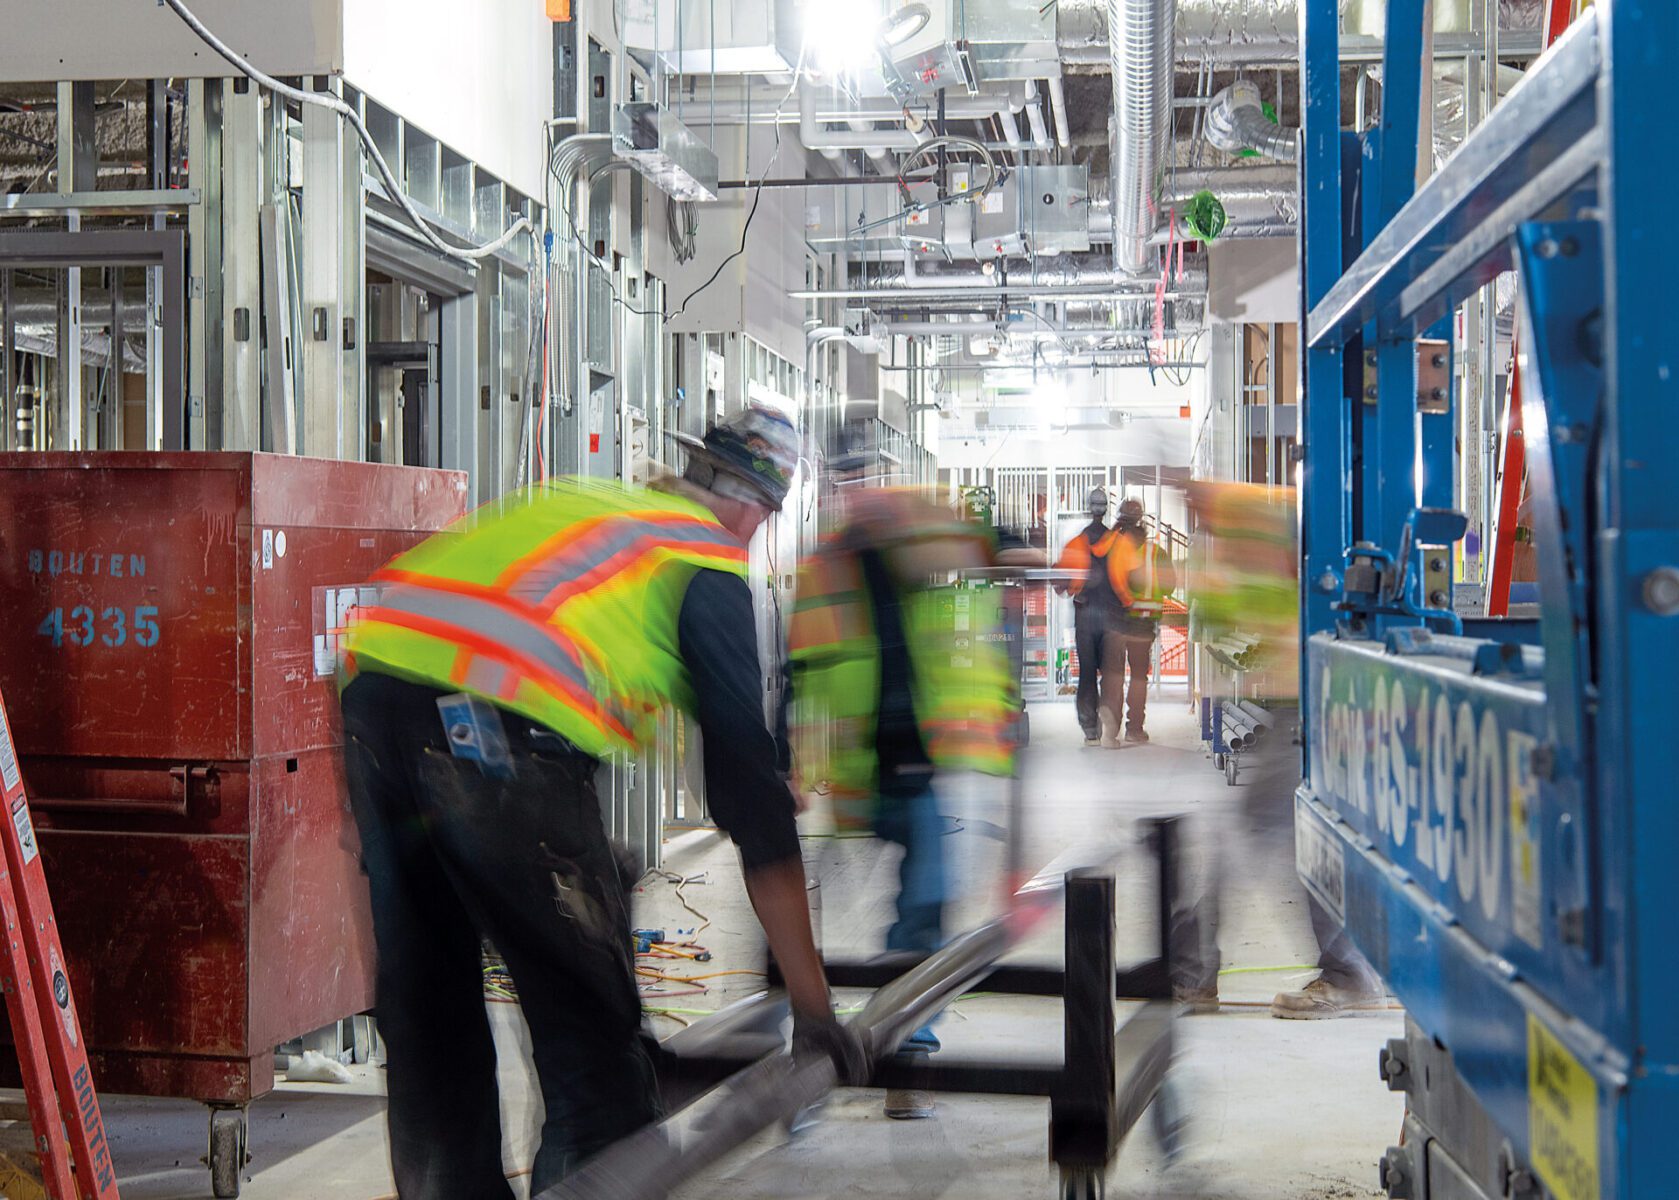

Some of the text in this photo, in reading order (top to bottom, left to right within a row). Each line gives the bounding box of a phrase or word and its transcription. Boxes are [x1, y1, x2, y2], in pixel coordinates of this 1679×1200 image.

[28, 549, 146, 577] BOUTEN
[38, 605, 160, 647] 4335
[1373, 675, 1500, 921] GS-1930
[73, 1062, 112, 1193] BOUTEN
